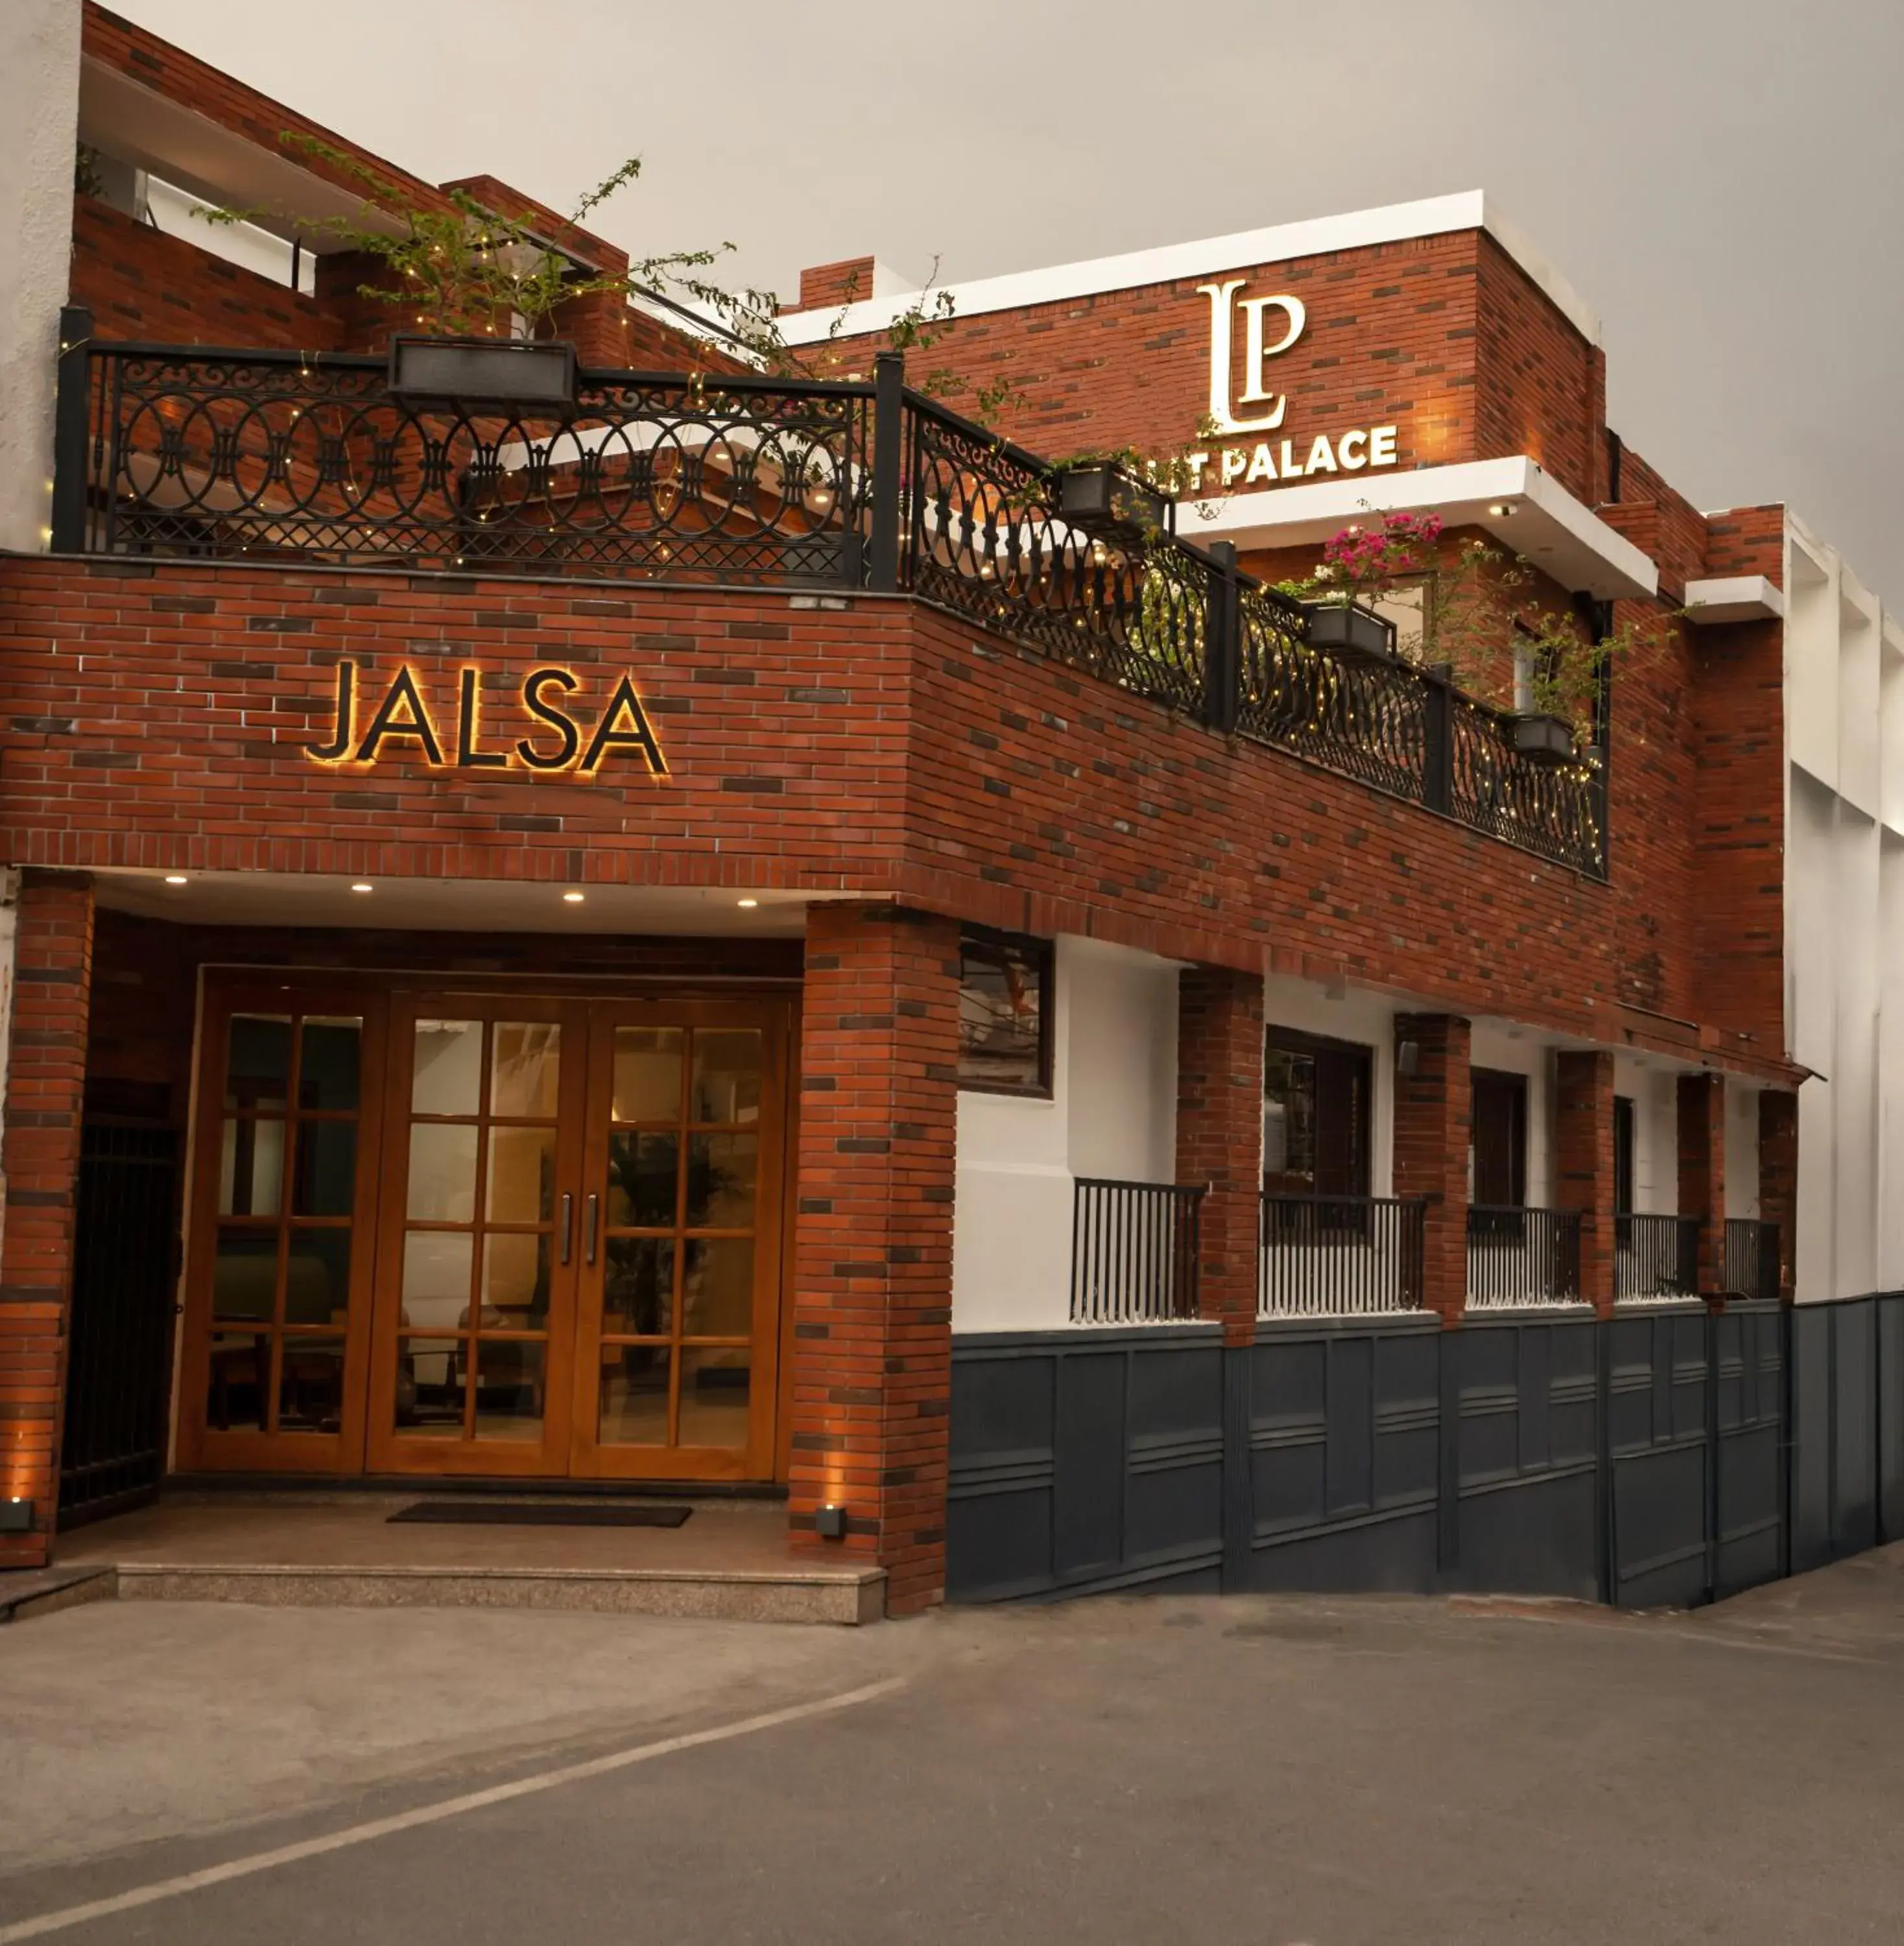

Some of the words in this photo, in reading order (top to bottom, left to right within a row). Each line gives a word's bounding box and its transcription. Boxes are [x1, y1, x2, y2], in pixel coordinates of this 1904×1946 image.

[1196, 279, 1306, 438] LP
[1221, 426, 1398, 486] PALACE
[305, 660, 671, 775] JALSA
